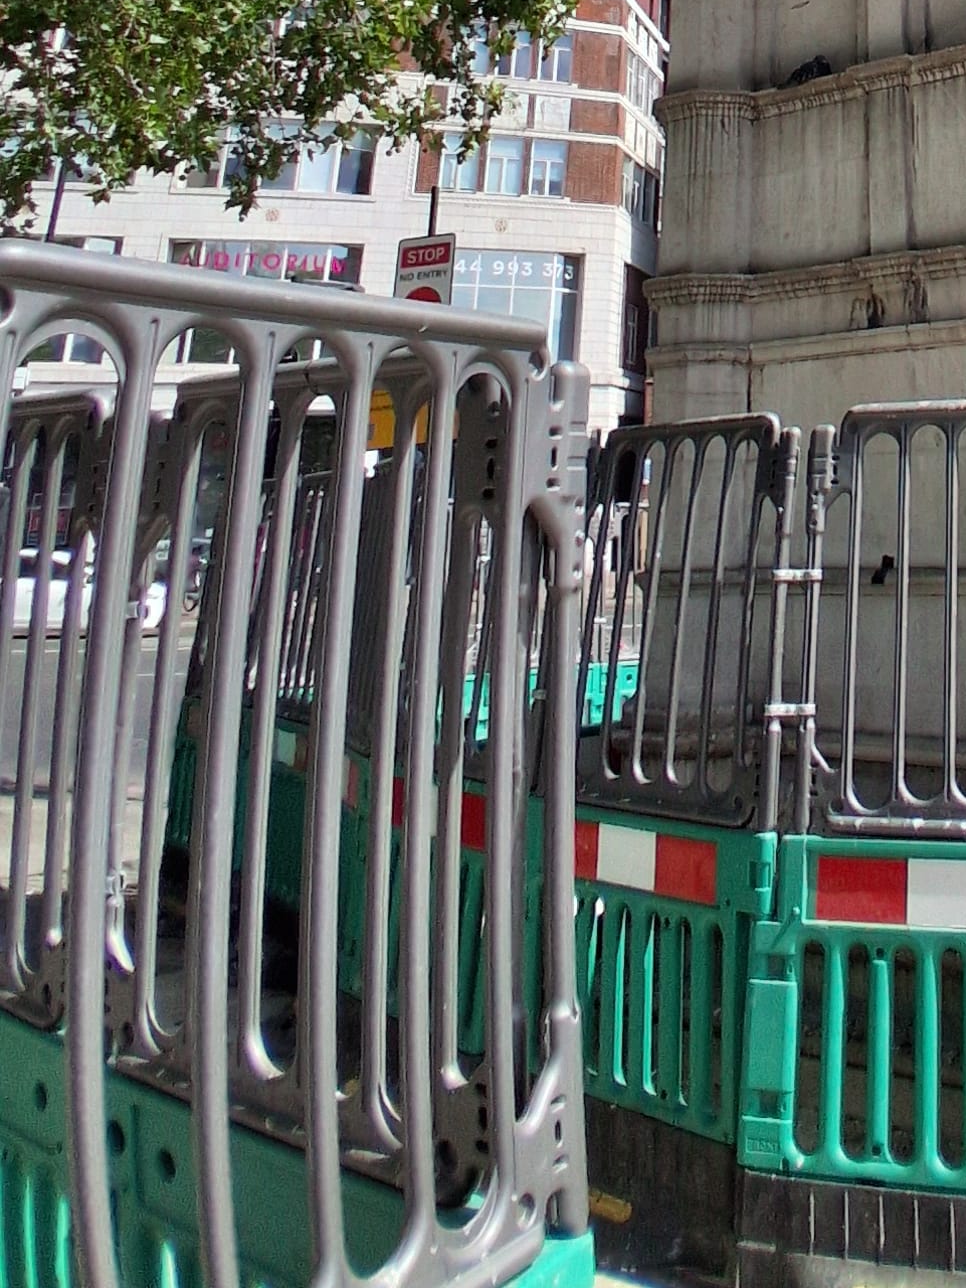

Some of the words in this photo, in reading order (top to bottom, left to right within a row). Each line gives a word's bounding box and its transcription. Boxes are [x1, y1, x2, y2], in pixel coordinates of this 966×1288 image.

[407, 247, 445, 264] STOP
[493, 261, 533, 275] 993
[400, 273, 415, 282] NO
[417, 269, 448, 281] ENTRY
